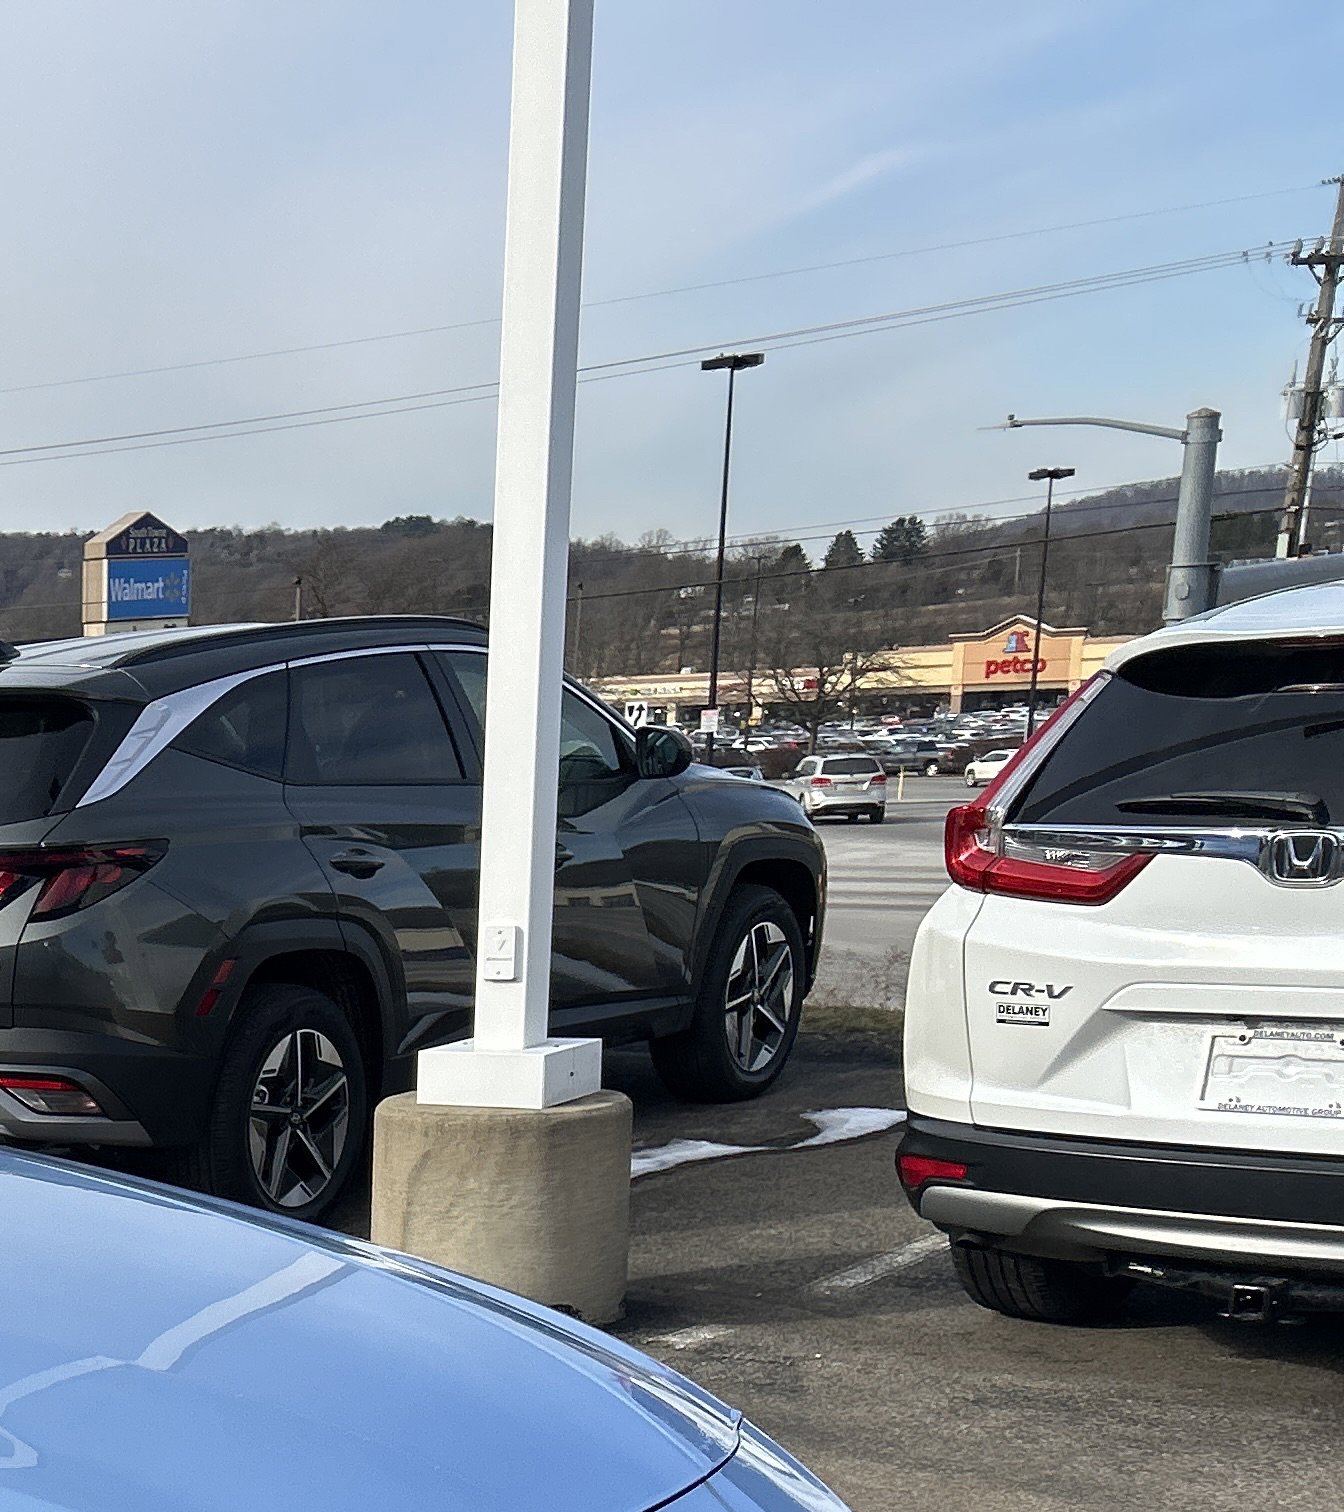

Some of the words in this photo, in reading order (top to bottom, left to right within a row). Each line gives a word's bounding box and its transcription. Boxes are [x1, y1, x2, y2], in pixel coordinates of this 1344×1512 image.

[128, 538, 168, 553] PLAZA
[110, 576, 164, 602] Walmart
[985, 656, 1046, 679] petco
[988, 980, 1074, 1000] CR-V
[998, 1004, 1048, 1017] DELANEY
[1217, 1102, 1255, 1112] DELANEY
[1256, 1105, 1310, 1115] AUTOMOTIVE
[1311, 1108, 1342, 1117] GROUP
